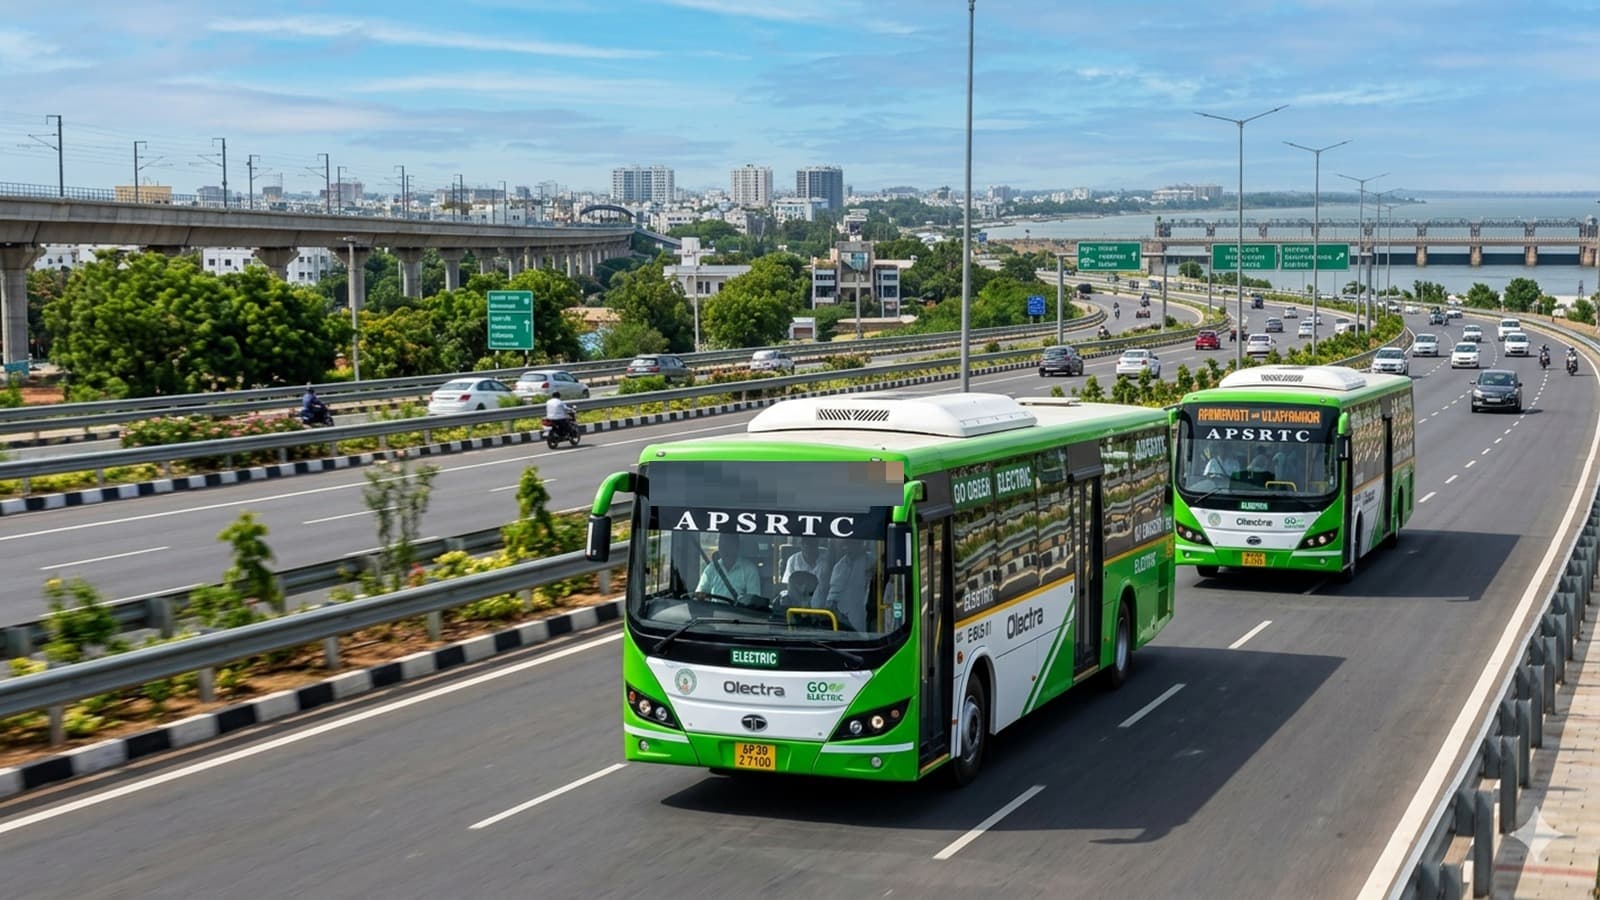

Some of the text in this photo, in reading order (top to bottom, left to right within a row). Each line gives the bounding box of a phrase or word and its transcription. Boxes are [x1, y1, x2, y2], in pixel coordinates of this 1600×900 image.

[1206, 428, 1310, 442] APSRTC
[673, 511, 854, 537] APSRTC
[1006, 606, 1044, 640] Olectra
[723, 680, 785, 697] Olectra
[807, 681, 828, 693] GO
